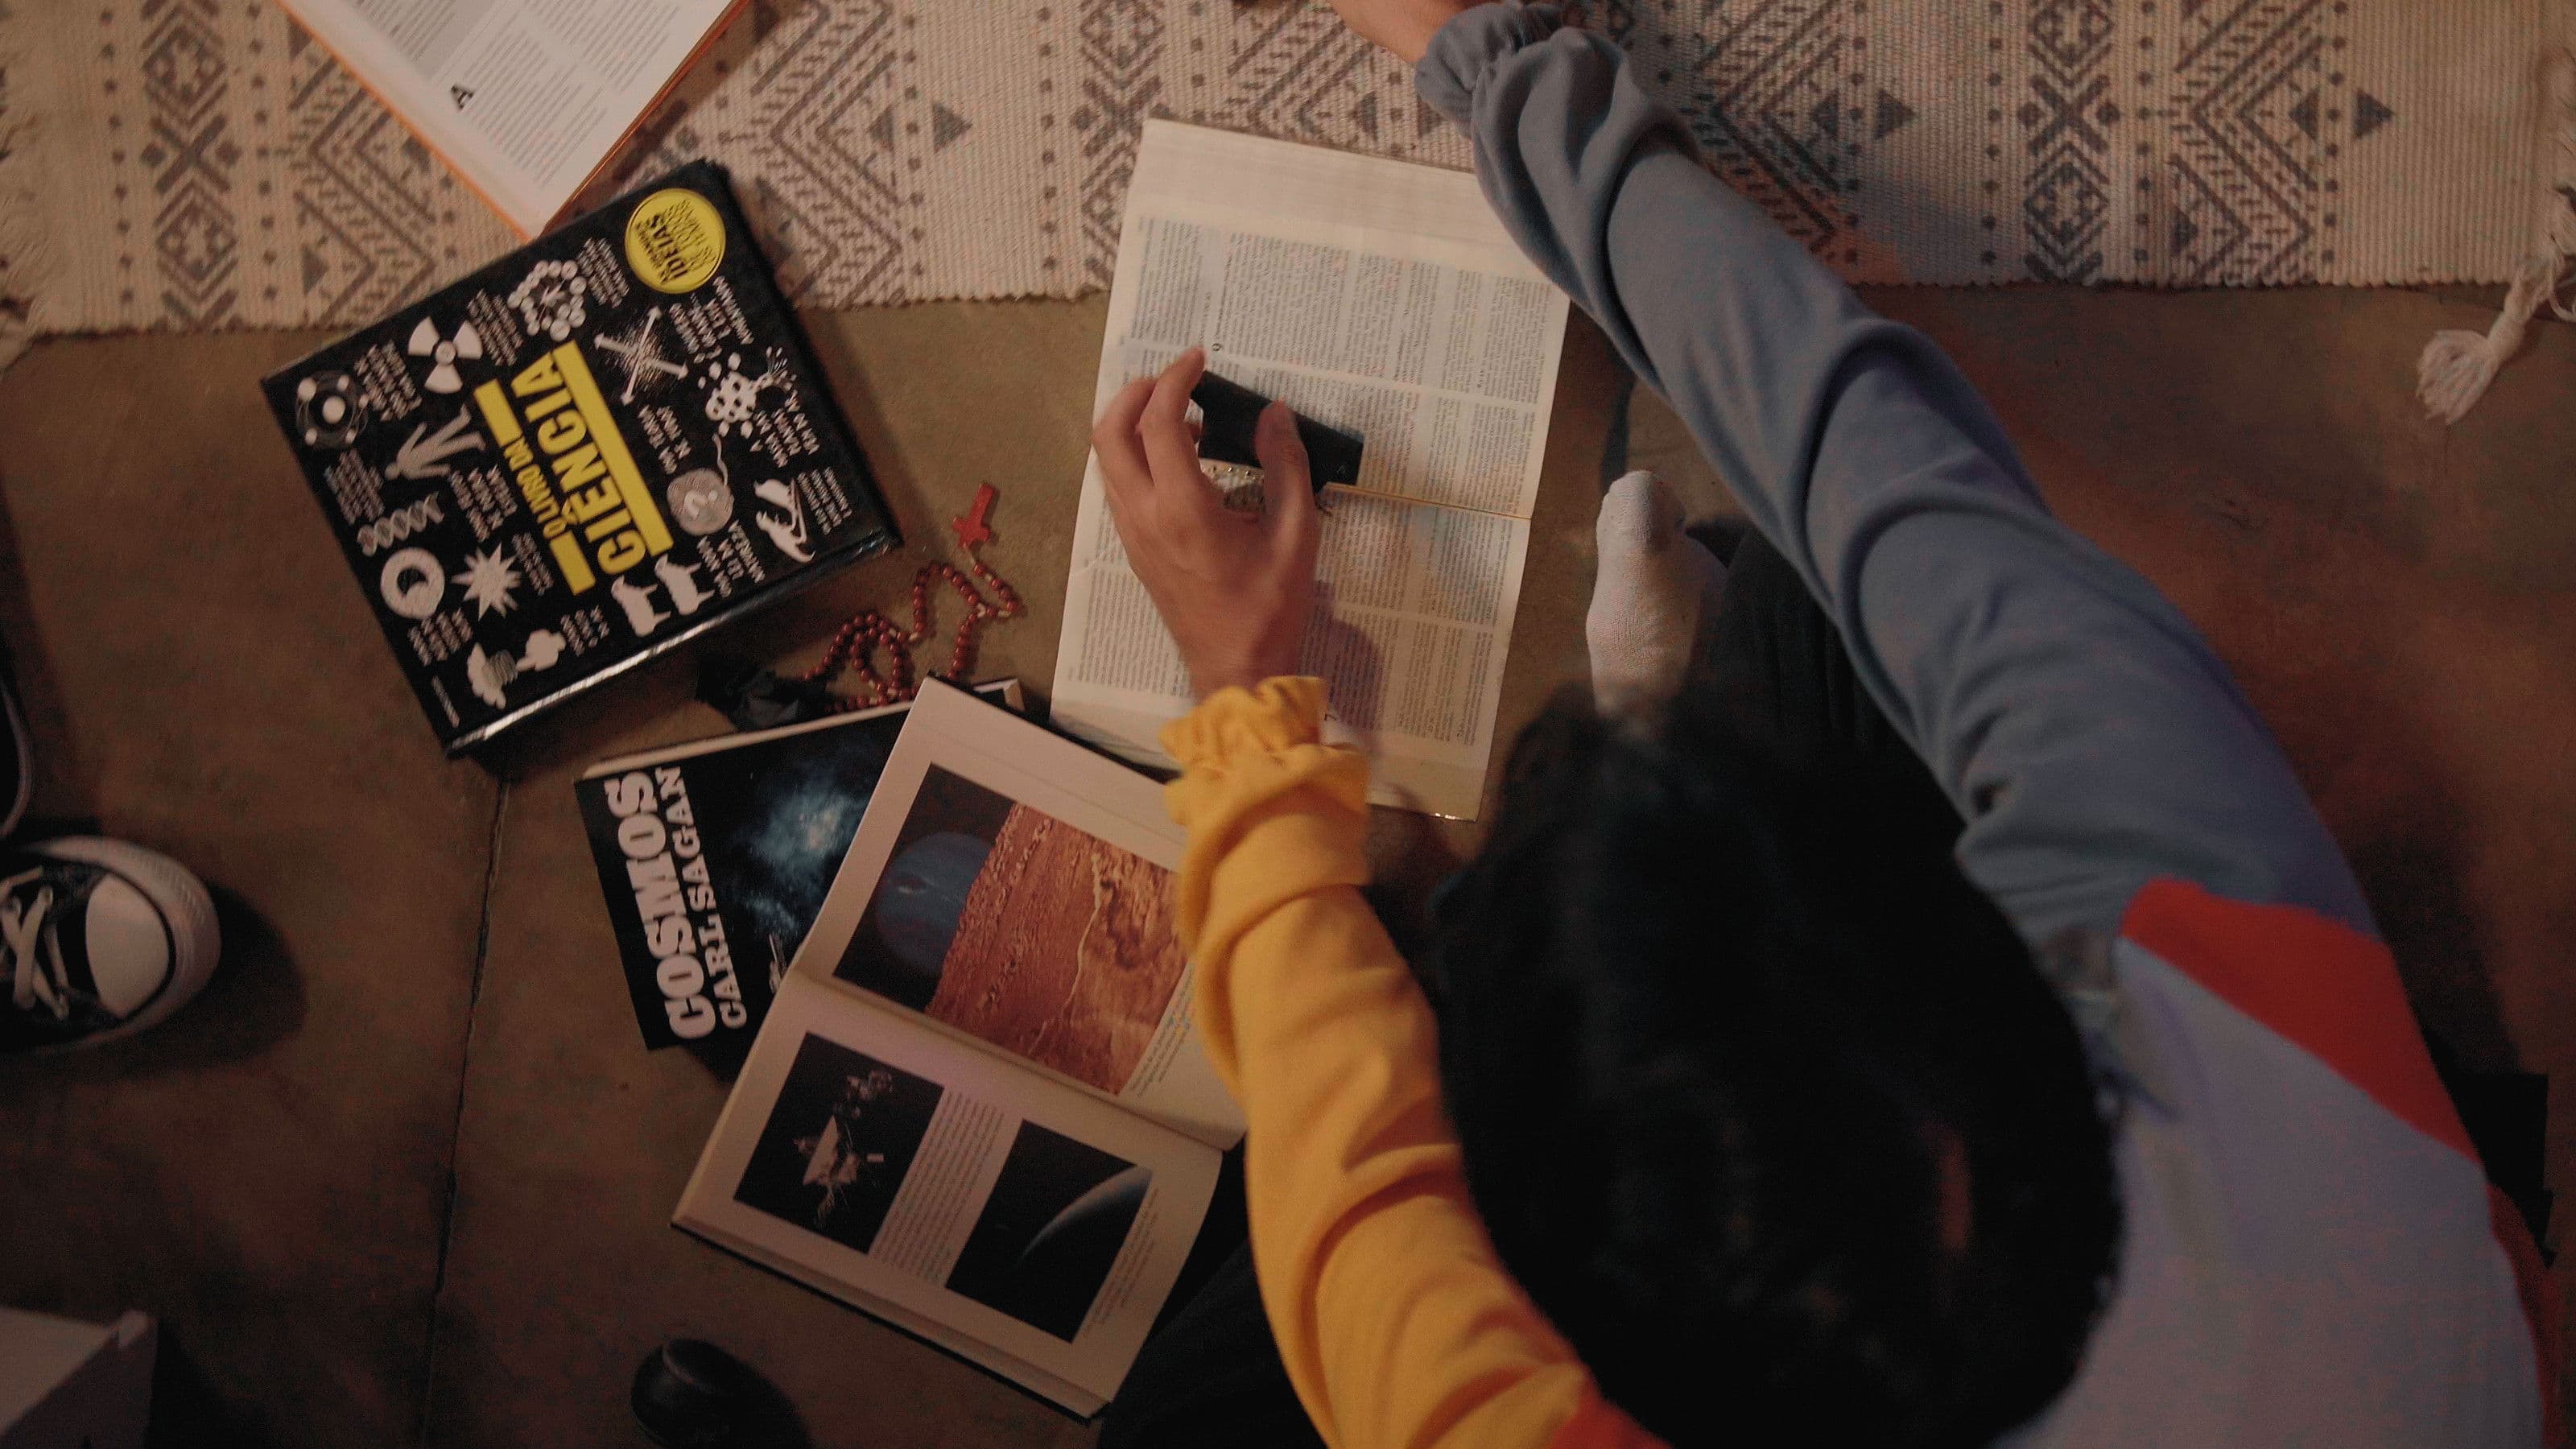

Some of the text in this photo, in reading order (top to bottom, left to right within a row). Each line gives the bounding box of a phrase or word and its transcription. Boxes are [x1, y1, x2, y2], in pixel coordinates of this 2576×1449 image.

[646, 214, 688, 279] IDEIAS
[503, 437, 532, 471] DA
[511, 349, 646, 573] CIÊNCIA
[519, 464, 560, 523] LIVRO
[544, 516, 563, 539] O
[605, 771, 716, 1038] COSMOS
[655, 766, 747, 1029] CARL SAGAN
